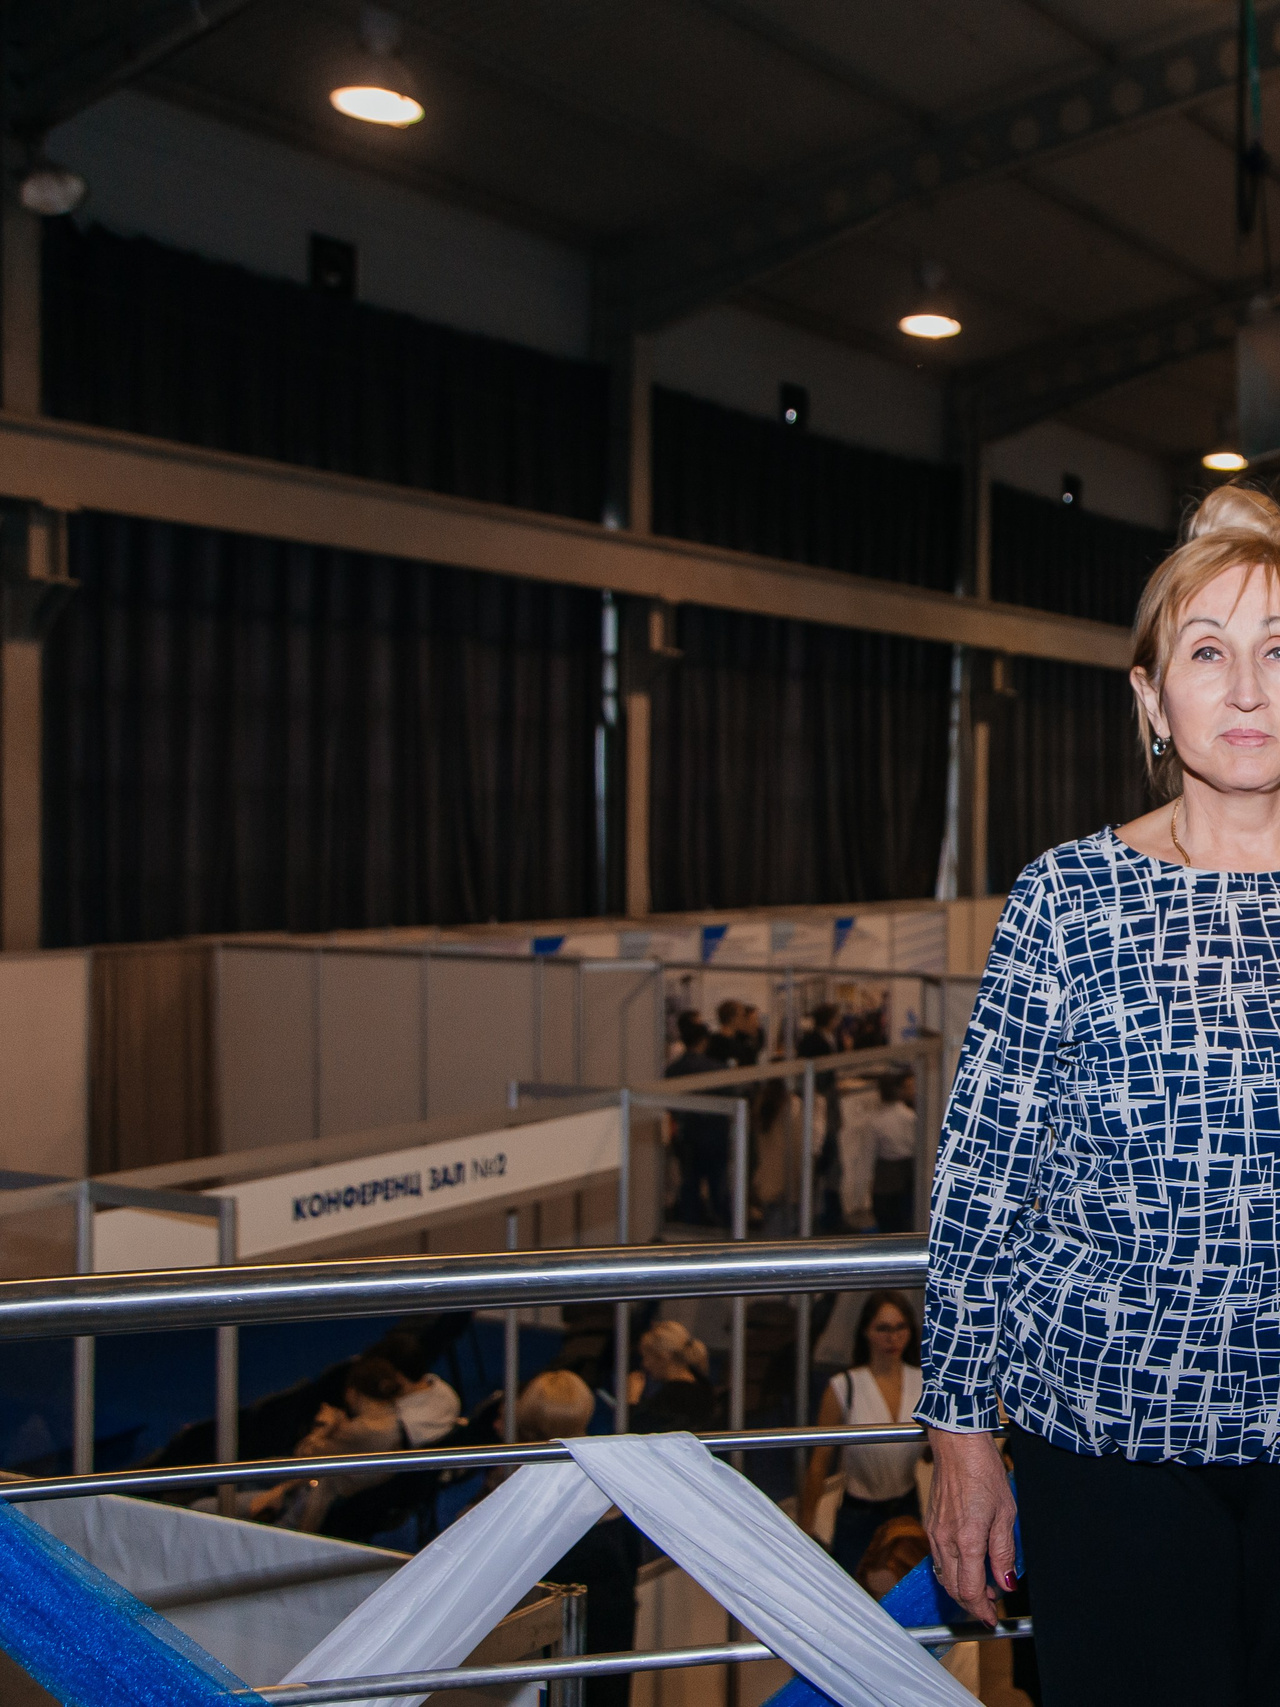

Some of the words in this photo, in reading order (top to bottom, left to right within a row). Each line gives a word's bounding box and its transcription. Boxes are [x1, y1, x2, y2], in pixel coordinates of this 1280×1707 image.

[292, 1171, 423, 1222] КОНФЕРЕНЦ
[429, 1161, 466, 1191] ЗАЛ
[472, 1152, 507, 1180] №2
